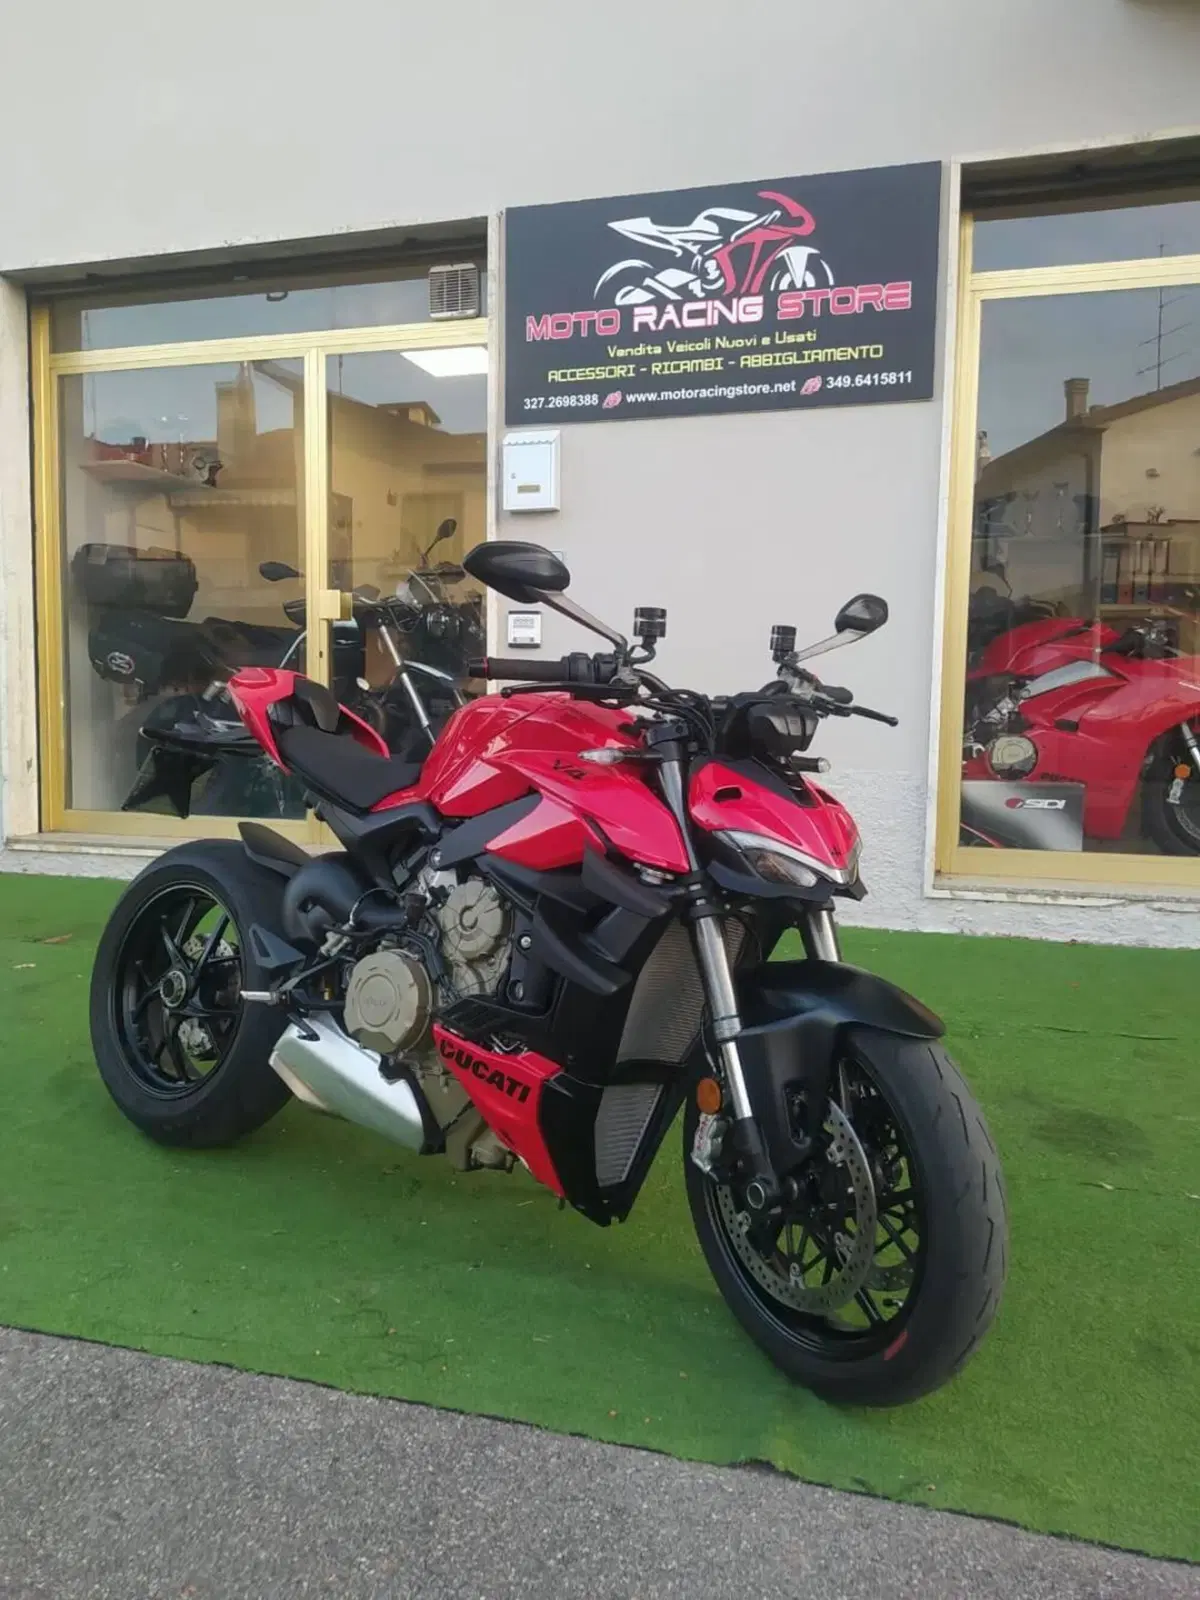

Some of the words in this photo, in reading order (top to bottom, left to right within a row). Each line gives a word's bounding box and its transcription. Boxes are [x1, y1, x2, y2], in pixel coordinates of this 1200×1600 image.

[526, 309, 620, 342] MOTO
[633, 295, 764, 333] RACING
[777, 281, 912, 320] STORE
[607, 342, 662, 358] Vendita
[667, 337, 711, 353] Veicoli
[715, 334, 757, 350] Nuovi
[761, 336, 770, 346] e
[775, 329, 817, 345] Usati
[548, 364, 636, 383] ACCESSORI
[651, 357, 724, 375] RICAMBI
[740, 344, 884, 369] ABBIGLIAMENTO
[523, 393, 599, 410] 327.2698388
[626, 380, 796, 402] www.motoracingstore.net
[826, 370, 913, 389] 349.6415811
